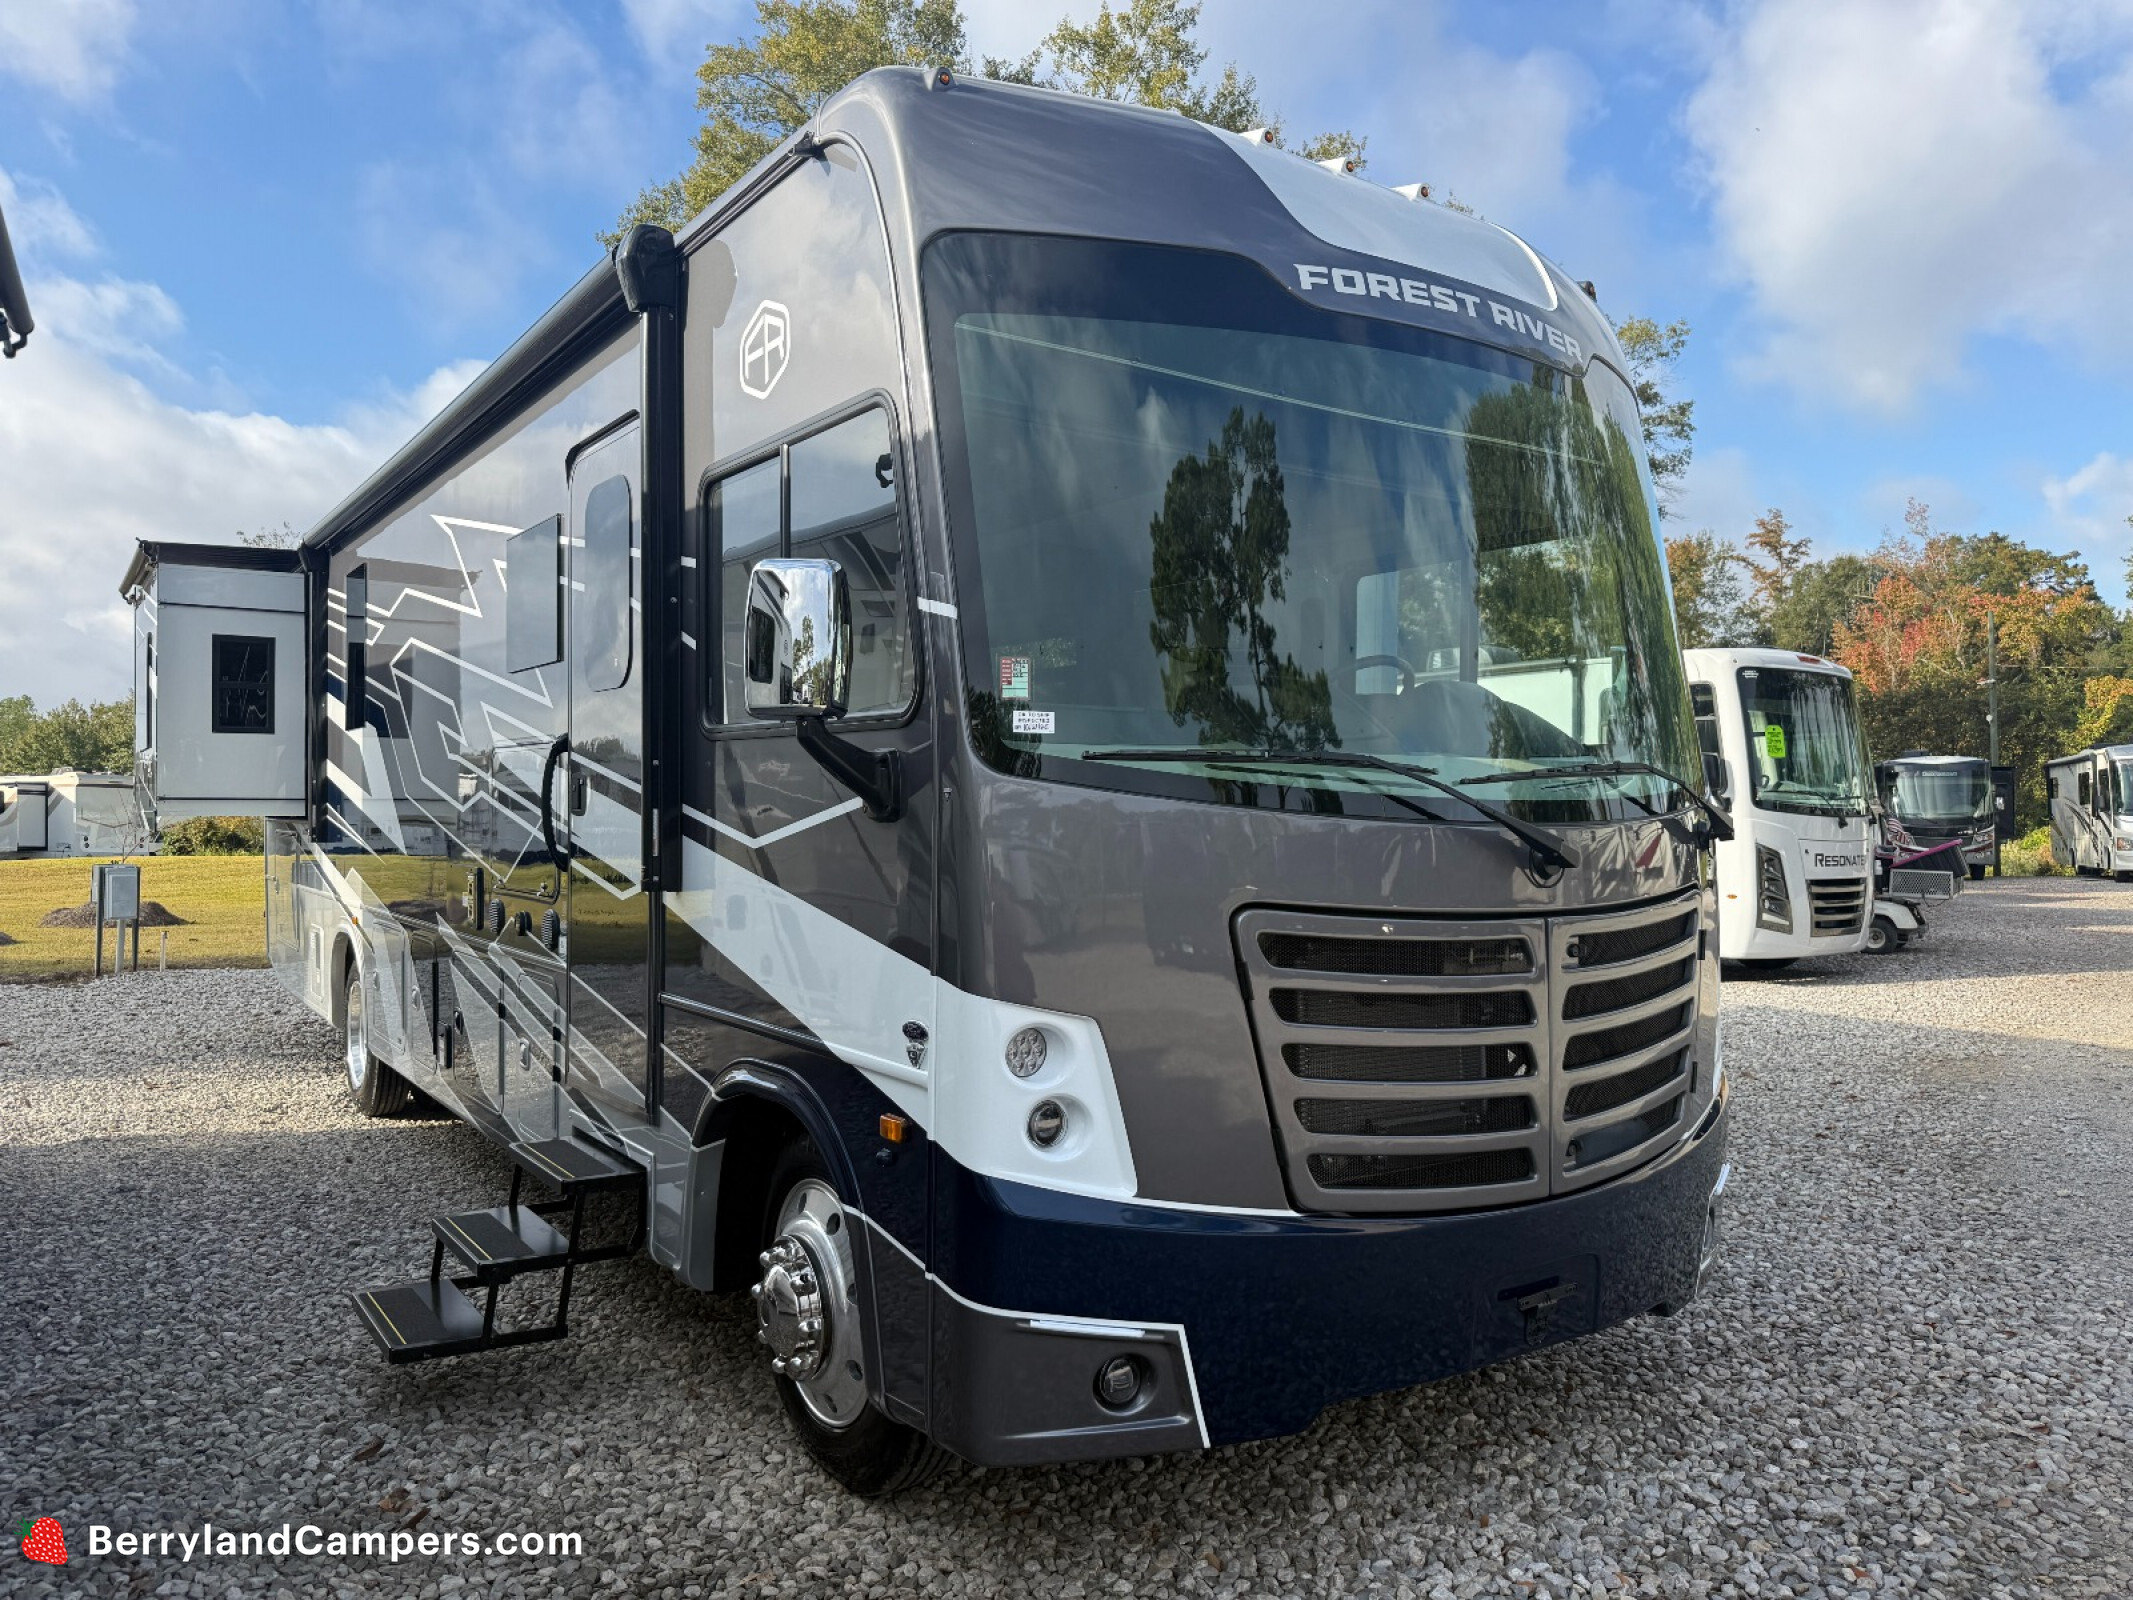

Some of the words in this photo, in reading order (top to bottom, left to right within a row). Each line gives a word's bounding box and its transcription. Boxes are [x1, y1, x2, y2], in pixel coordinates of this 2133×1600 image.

[1293, 263, 1481, 318] FOREST
[1488, 299, 1583, 362] RIVER
[1814, 852, 1866, 868] RESONATE
